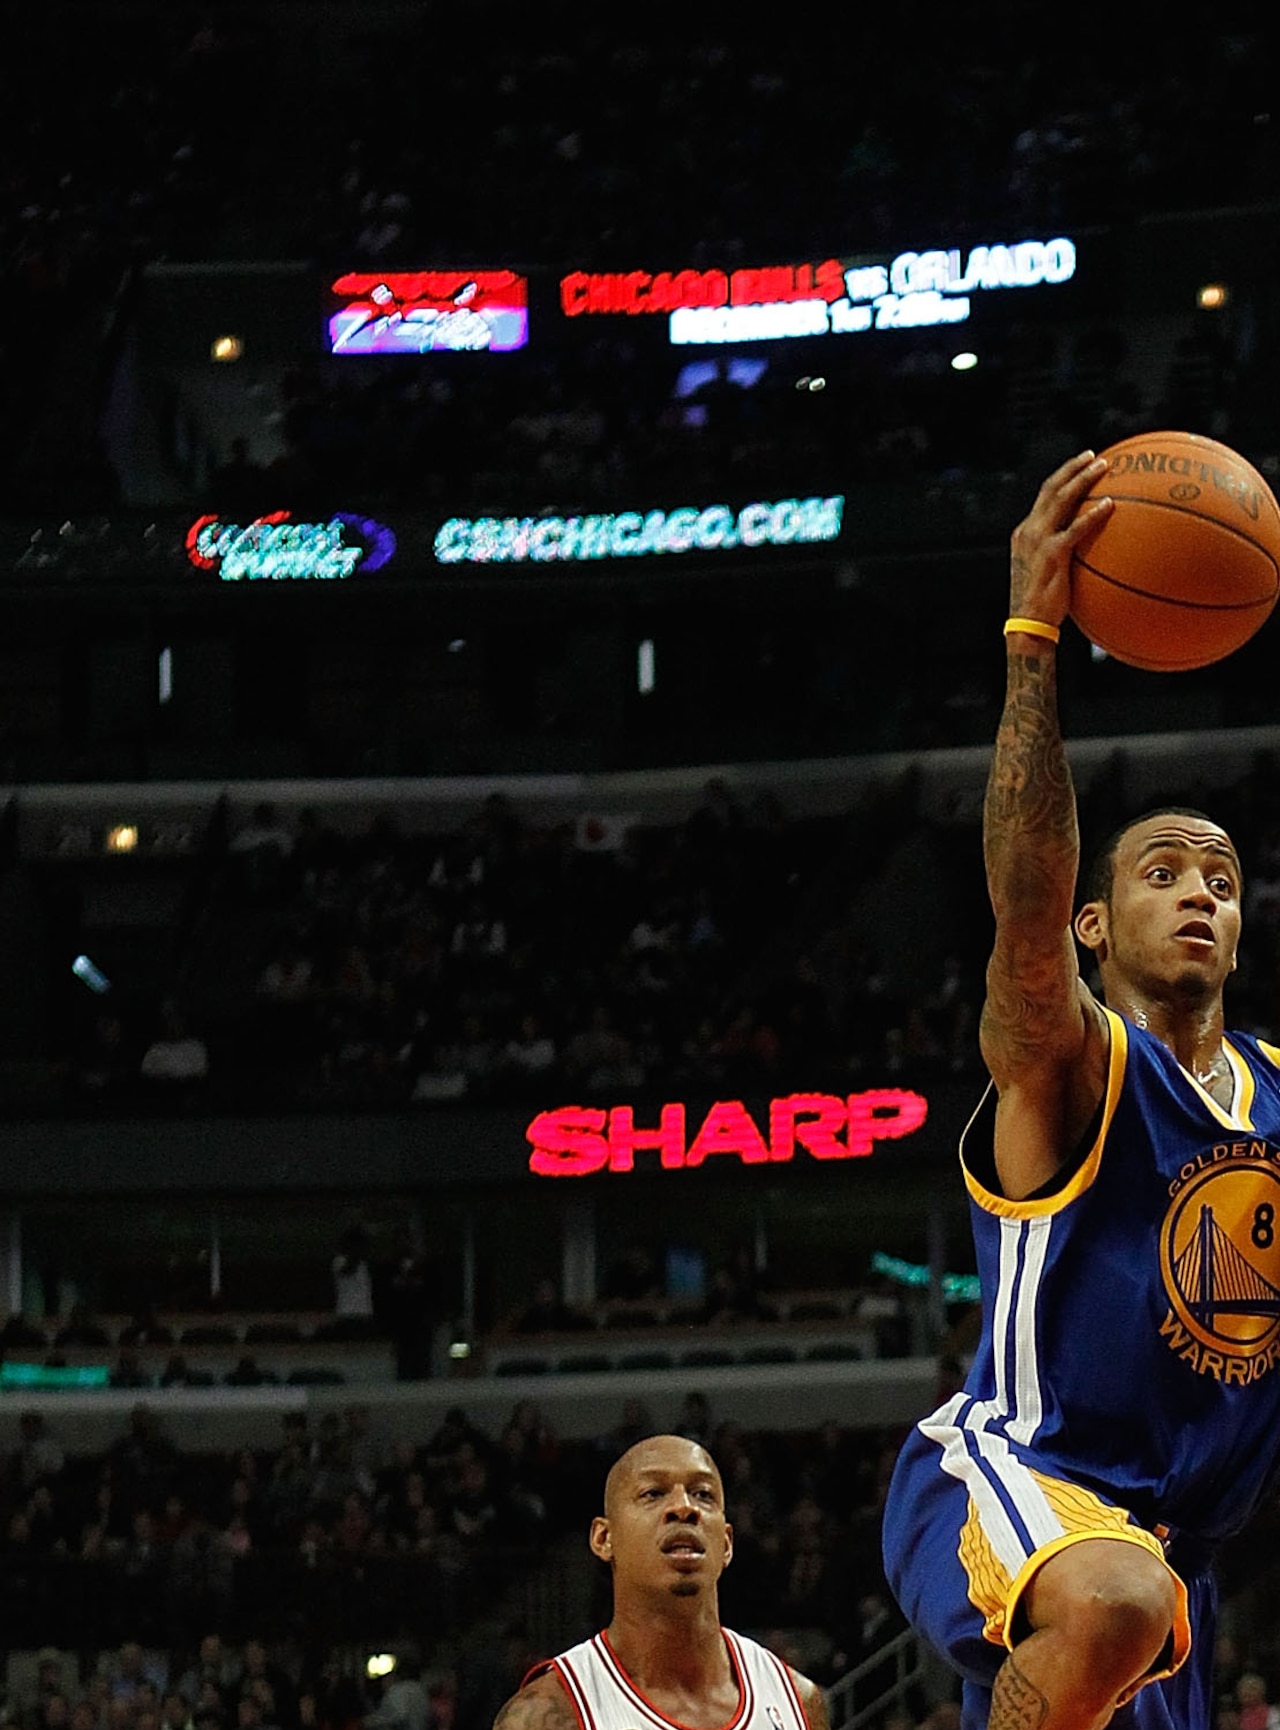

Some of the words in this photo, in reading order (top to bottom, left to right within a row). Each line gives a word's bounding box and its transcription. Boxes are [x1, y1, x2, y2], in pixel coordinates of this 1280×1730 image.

[890, 238, 1076, 296] ORLANDO
[526, 1088, 928, 1177] SHARP
[1168, 1141, 1266, 1198] GOLDEN
[1251, 1202, 1274, 1250] 8
